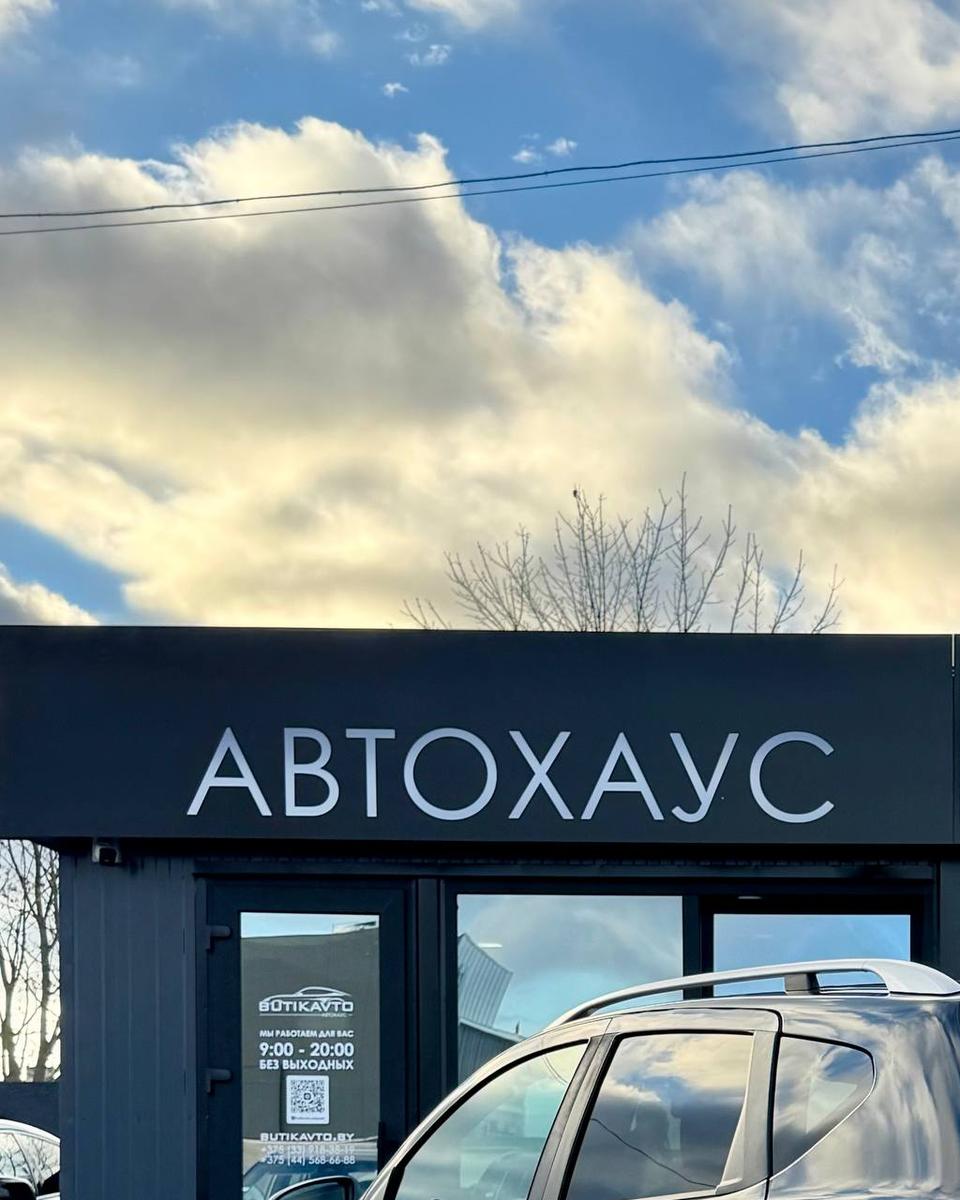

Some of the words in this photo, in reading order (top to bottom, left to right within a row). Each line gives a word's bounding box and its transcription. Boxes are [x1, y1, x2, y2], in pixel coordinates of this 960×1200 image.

[186, 726, 834, 824] АВТОХАУС
[258, 1000, 354, 1012] BUTIKAVTO
[318, 1030, 335, 1038] ДЛЯ
[259, 1042, 294, 1057] 9:00
[309, 1042, 354, 1057] 20:00
[259, 1059, 280, 1070] БЕЗ
[282, 1059, 354, 1071] ВЫХОДНЫХ
[260, 1133, 355, 1141] BUTIKAVTO.BY
[261, 1156, 284, 1164] +375
[287, 1155, 305, 1166] (44)
[308, 1156, 355, 1165] 568-66-88
